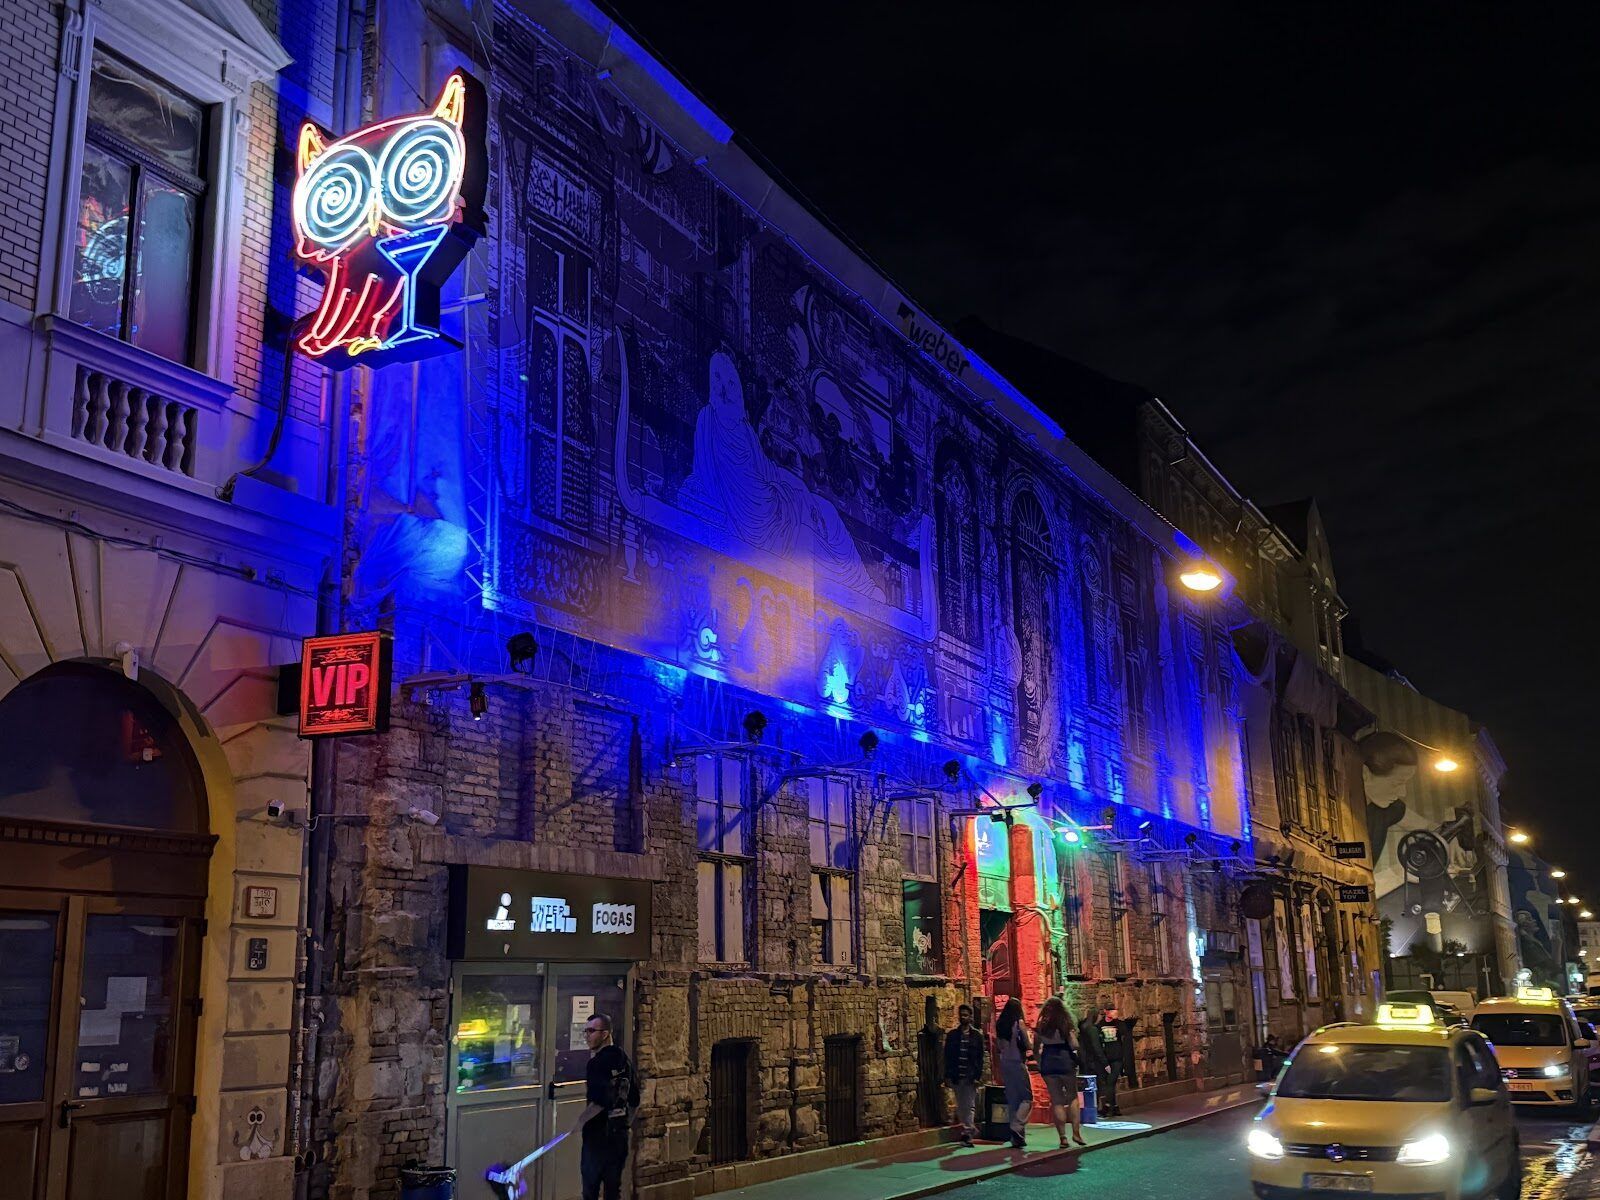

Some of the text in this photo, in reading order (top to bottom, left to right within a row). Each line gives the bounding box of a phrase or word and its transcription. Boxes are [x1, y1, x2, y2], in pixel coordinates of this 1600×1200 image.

[909, 321, 971, 377] weber
[312, 663, 369, 706] VIP
[595, 910, 633, 927] FOGAS
